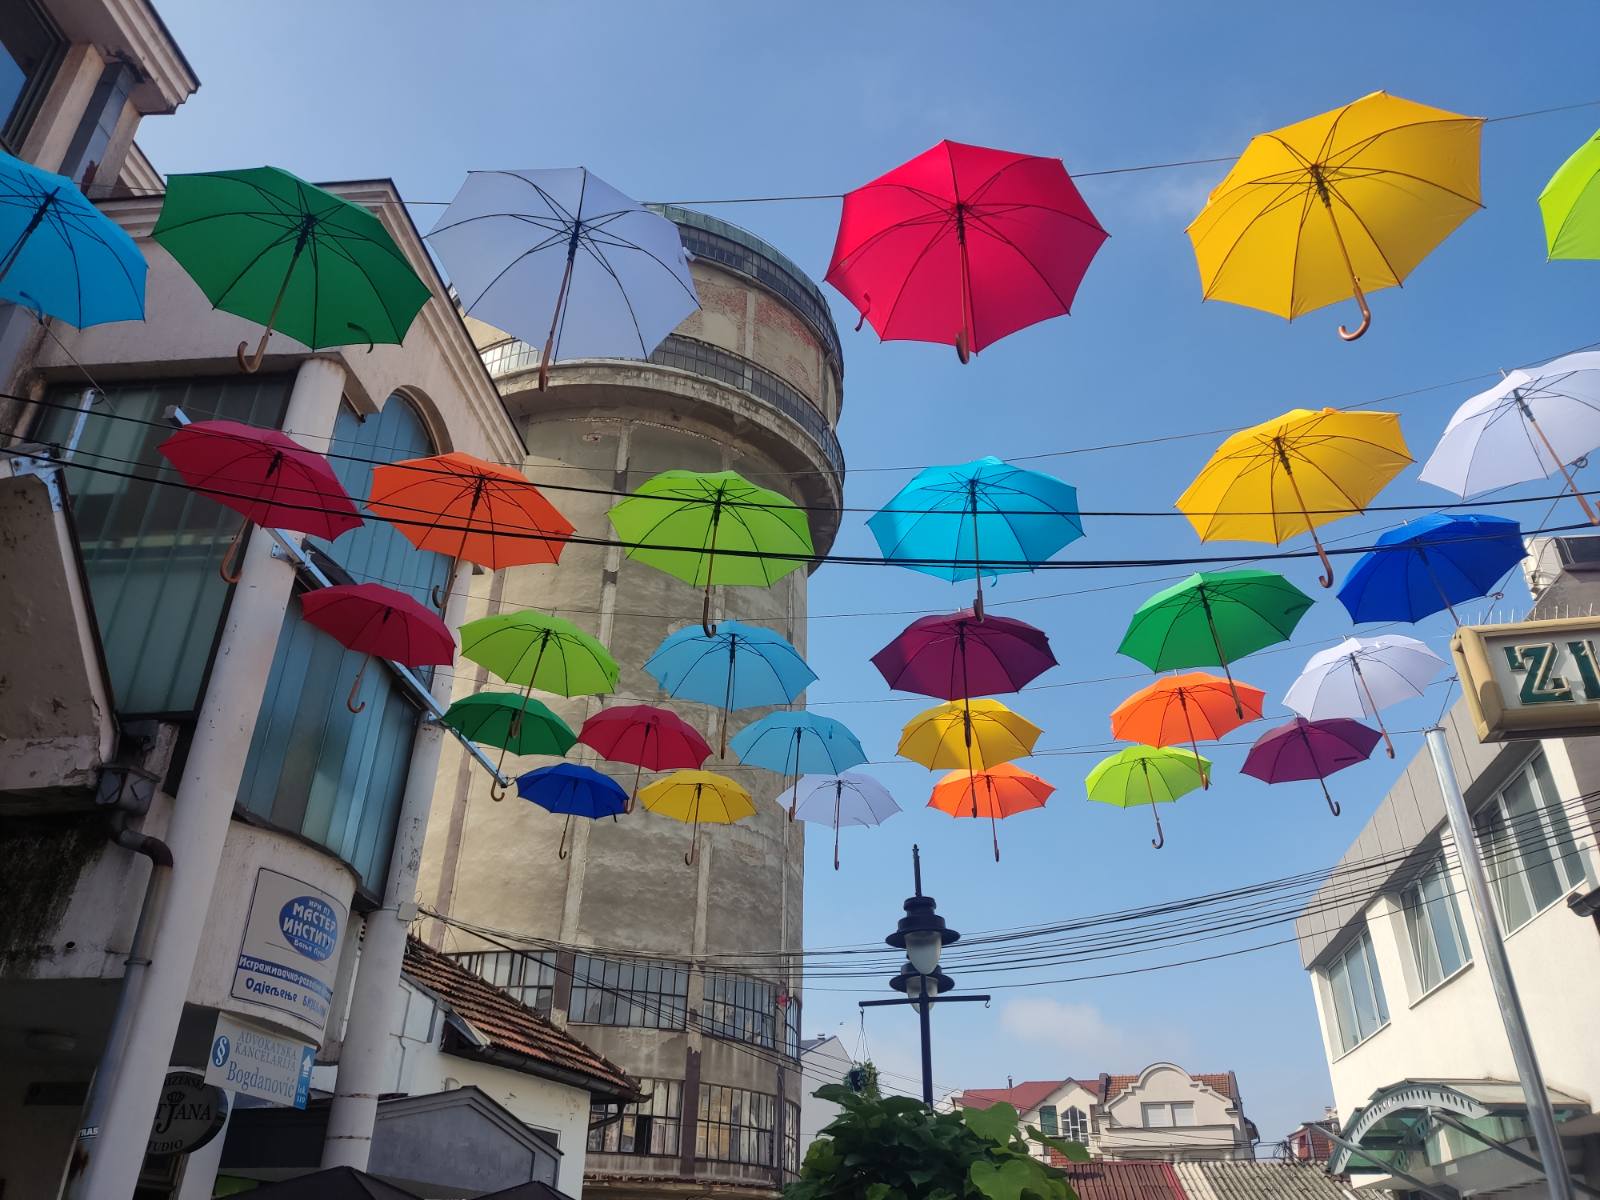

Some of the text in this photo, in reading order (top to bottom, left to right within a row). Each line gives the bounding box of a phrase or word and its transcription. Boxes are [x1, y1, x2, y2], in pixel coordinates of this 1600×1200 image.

[292, 902, 336, 931] МАСТЕР
[282, 917, 335, 953] ИНСТИТУТ
[238, 1031, 297, 1058] ADVOKATSKA
[226, 1060, 295, 1099] Bogdanović
[154, 1103, 211, 1134] TJANA
[147, 1139, 184, 1153] TUDIO
